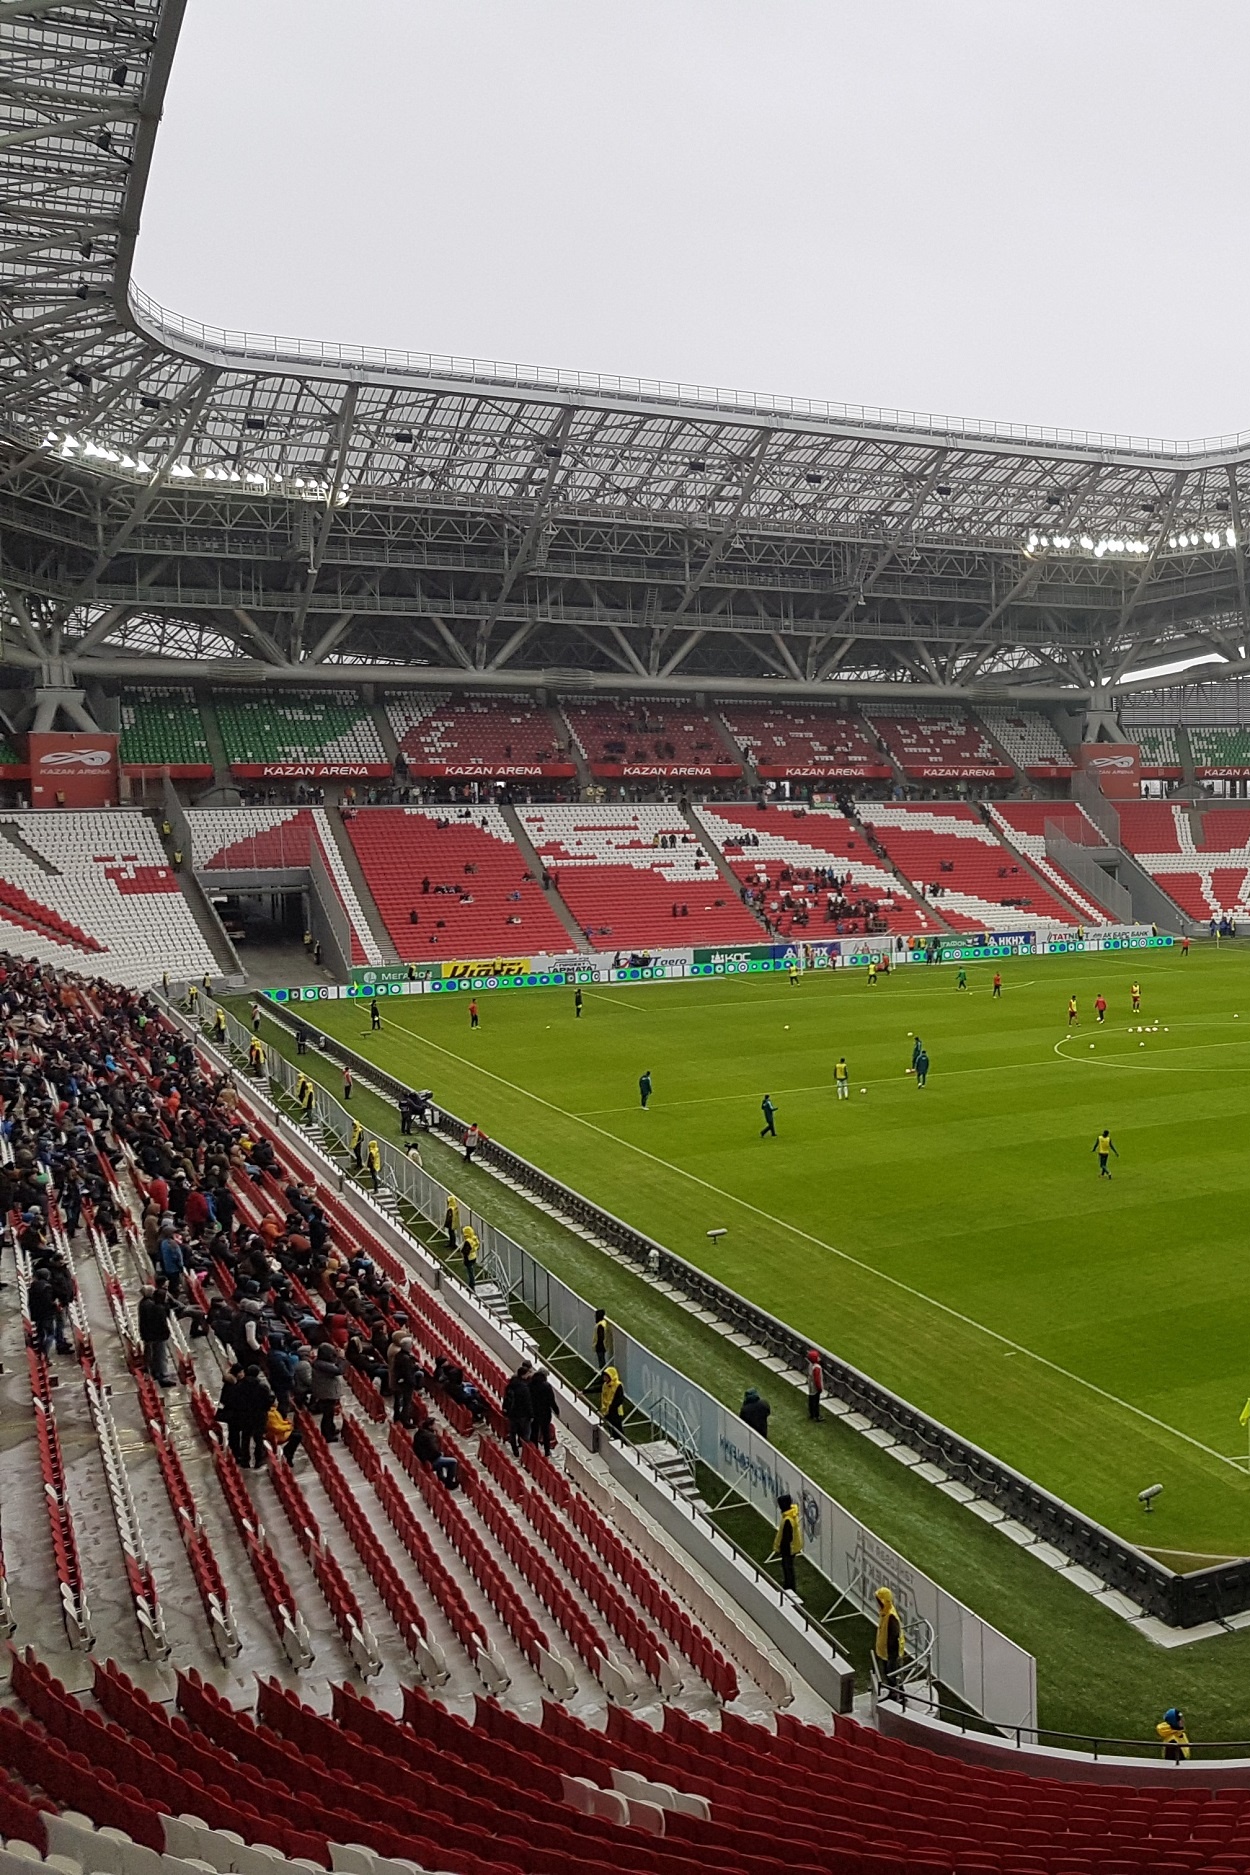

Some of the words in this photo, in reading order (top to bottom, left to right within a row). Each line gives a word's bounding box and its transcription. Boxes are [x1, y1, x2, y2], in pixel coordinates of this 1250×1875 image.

[264, 766, 315, 775] KAZAN
[320, 766, 368, 775] ARENA
[445, 766, 492, 775] KAZAN
[497, 766, 542, 775] ARENA
[623, 767, 667, 776] KAZAN
[670, 767, 712, 776] ARENA
[785, 768, 826, 776] KAZAN
[829, 768, 865, 776] ARENA
[999, 936, 1025, 945] НКНХ
